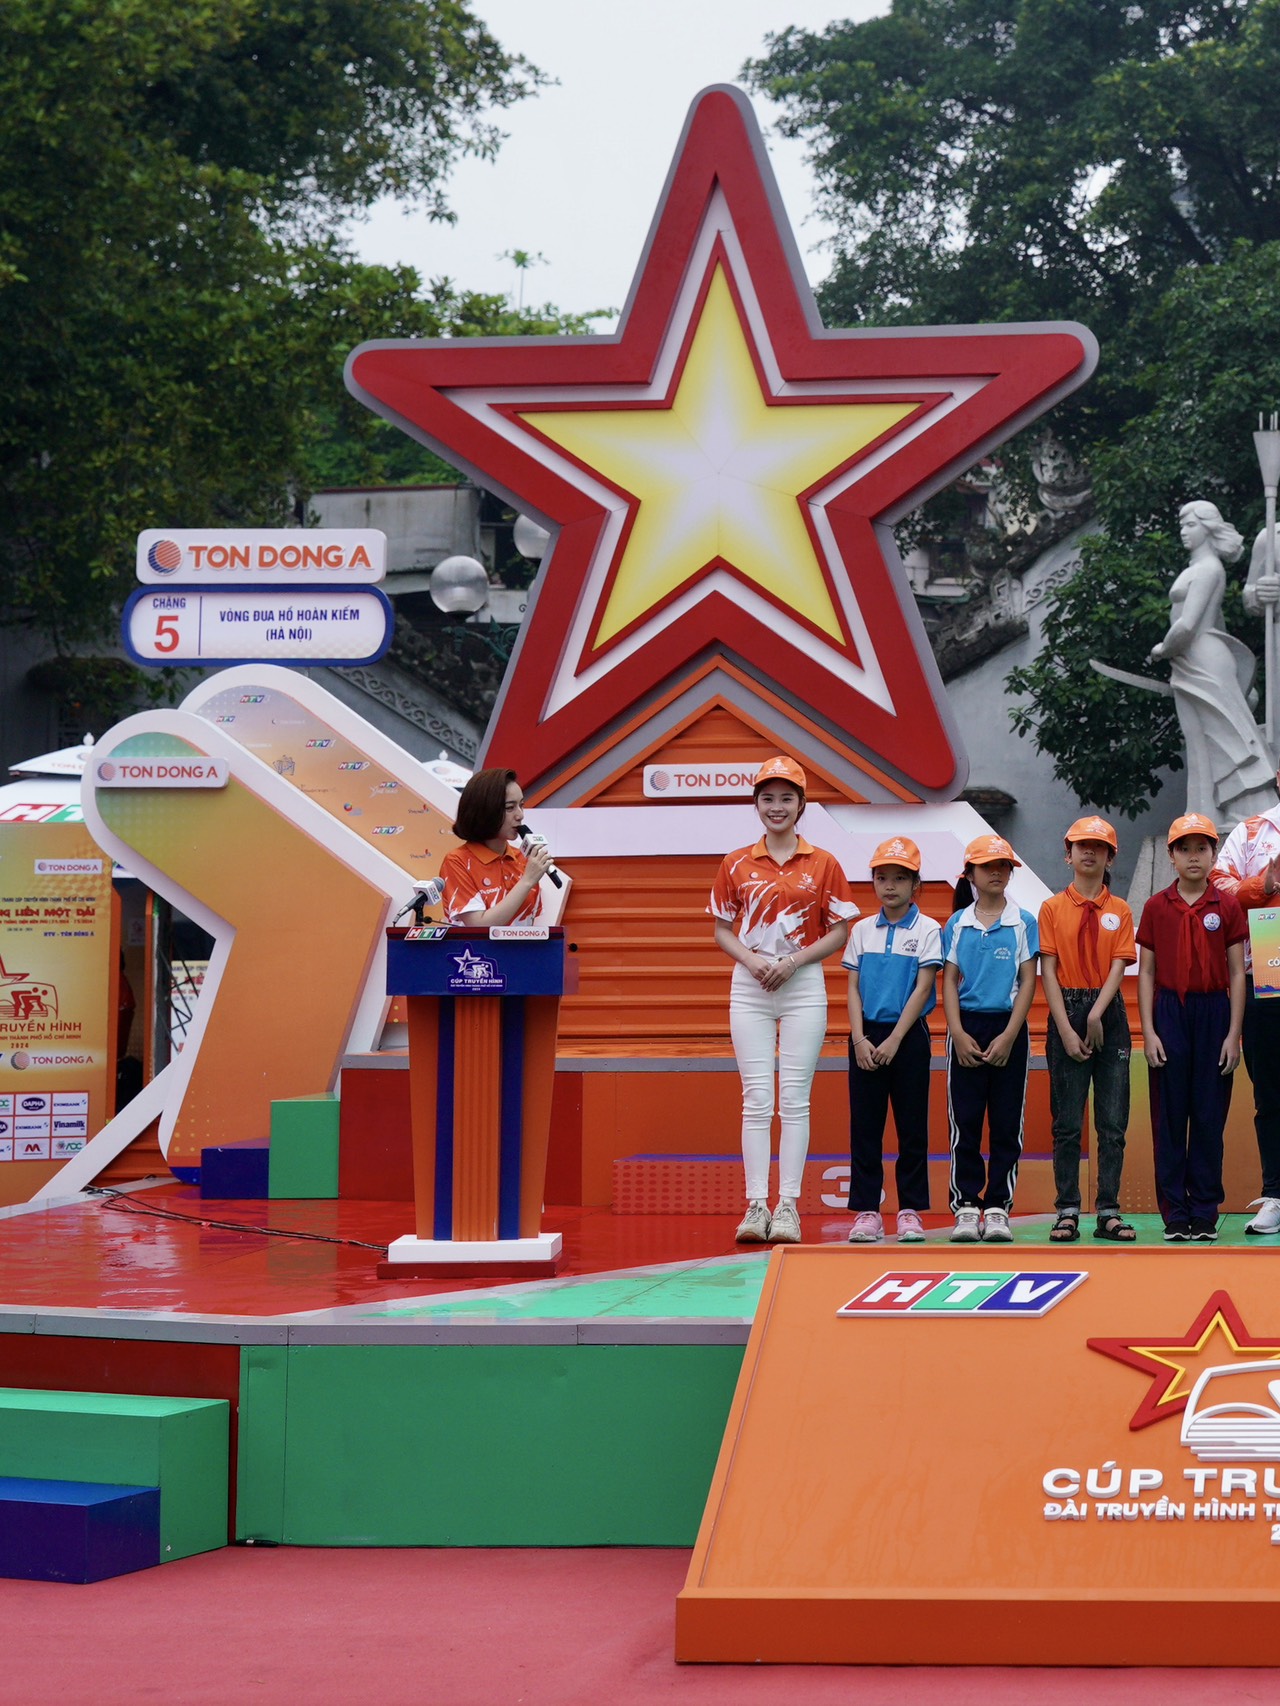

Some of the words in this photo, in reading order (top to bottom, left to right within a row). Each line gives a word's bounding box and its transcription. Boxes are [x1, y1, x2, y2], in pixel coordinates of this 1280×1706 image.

[188, 545, 250, 569] TON
[258, 545, 344, 569] DONG
[349, 545, 372, 568] A
[219, 608, 250, 622] VÒNG
[253, 610, 275, 621] ĐUA
[297, 606, 328, 621] HOÀN
[331, 604, 360, 621] KIẾM
[154, 615, 180, 653] 5
[265, 626, 285, 641] (HÀ
[288, 625, 313, 642] NỘI)
[119, 765, 153, 779] TON
[157, 765, 203, 779] DONG
[206, 765, 218, 778] A
[674, 774, 711, 788] TON
[15, 906, 39, 916] LIỀN
[44, 906, 71, 918] MỘT
[76, 906, 95, 917] DẢI
[407, 928, 445, 938] HTV
[1267, 956, 1280, 967] CÓ
[50, 1020, 82, 1032] HÌNH
[31, 1056, 53, 1065] TON
[53, 1120, 86, 1128] Vinamilk
[861, 1279, 1064, 1303] HTV
[1042, 1461, 1164, 1498] CÚP
[1043, 1498, 1088, 1521] ĐÀI
[1095, 1495, 1186, 1521] TRUYỀN
[1193, 1497, 1256, 1522] HÌNH
